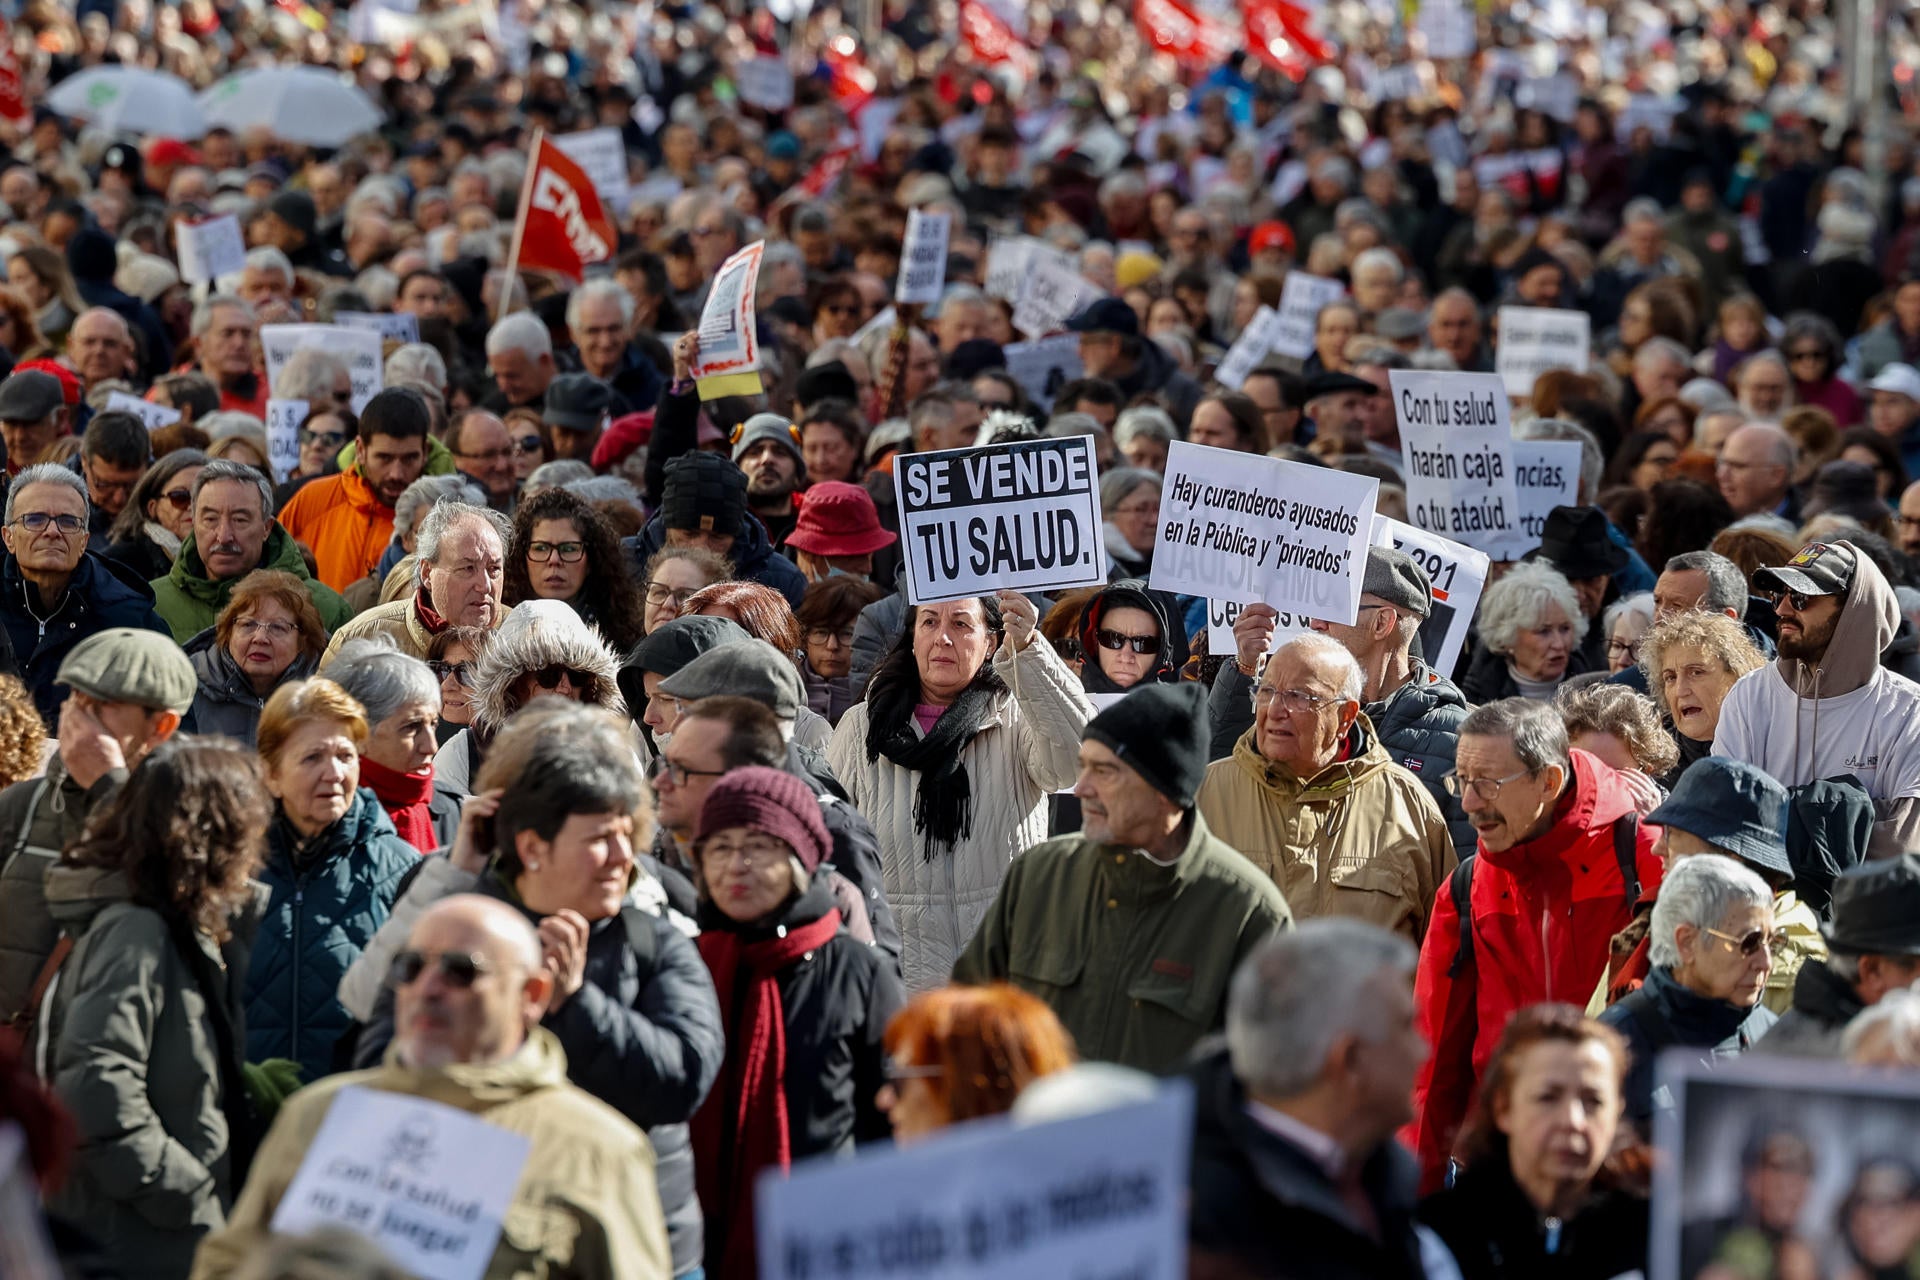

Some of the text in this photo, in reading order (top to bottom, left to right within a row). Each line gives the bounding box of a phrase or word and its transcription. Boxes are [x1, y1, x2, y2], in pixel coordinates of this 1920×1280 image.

[1402, 389, 1497, 426] Con tu salud
[907, 447, 1089, 506] SE VENDE
[1409, 441, 1504, 487] harán caja
[1171, 473, 1358, 536] Hay curanderos ayusados
[1416, 496, 1512, 533] o tu ataúd.
[917, 508, 1090, 582] TU SALUD.
[1164, 518, 1352, 577] en la Pública y "privados".
